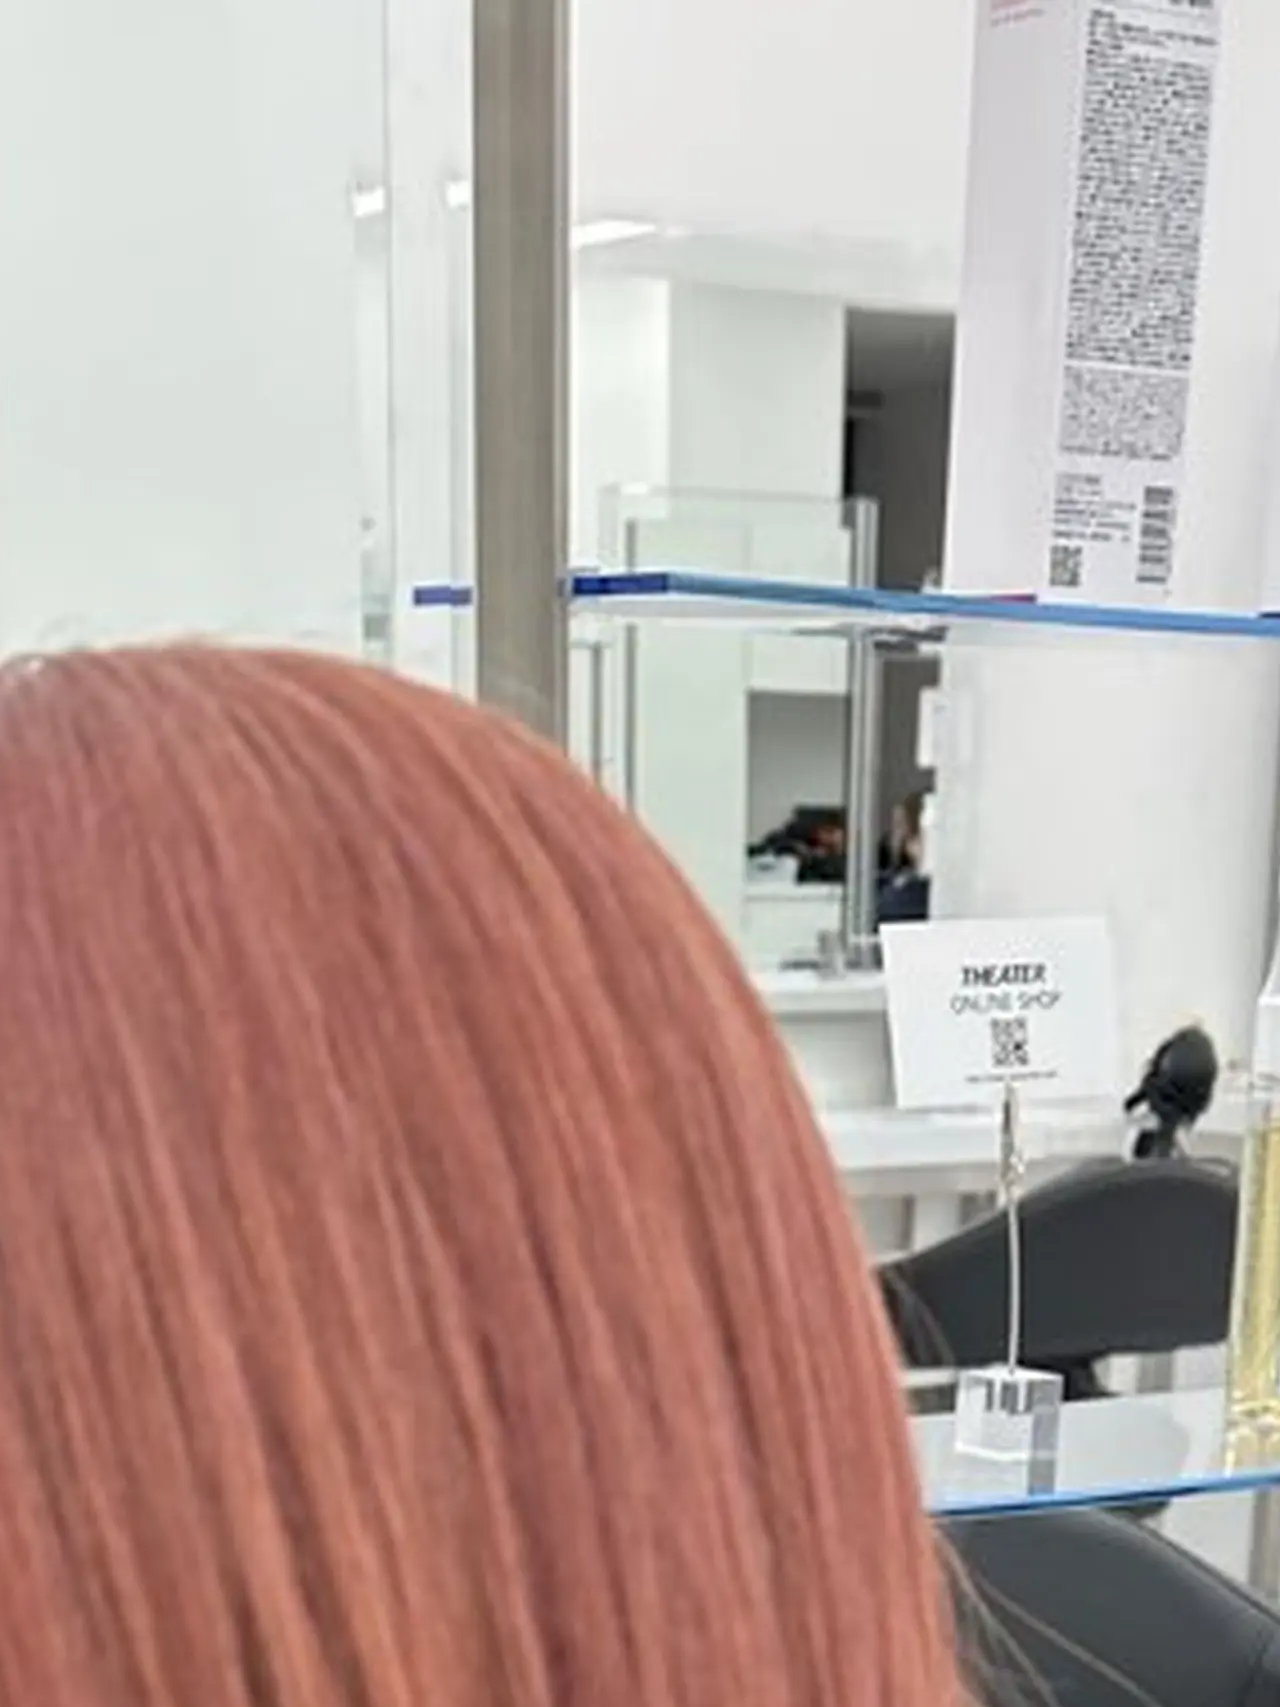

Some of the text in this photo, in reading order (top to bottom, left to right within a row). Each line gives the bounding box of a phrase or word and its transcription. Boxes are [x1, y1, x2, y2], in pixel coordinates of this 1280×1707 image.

[961, 963, 1047, 988] THEATER
[949, 990, 1063, 1015] ONLINE SHOP
